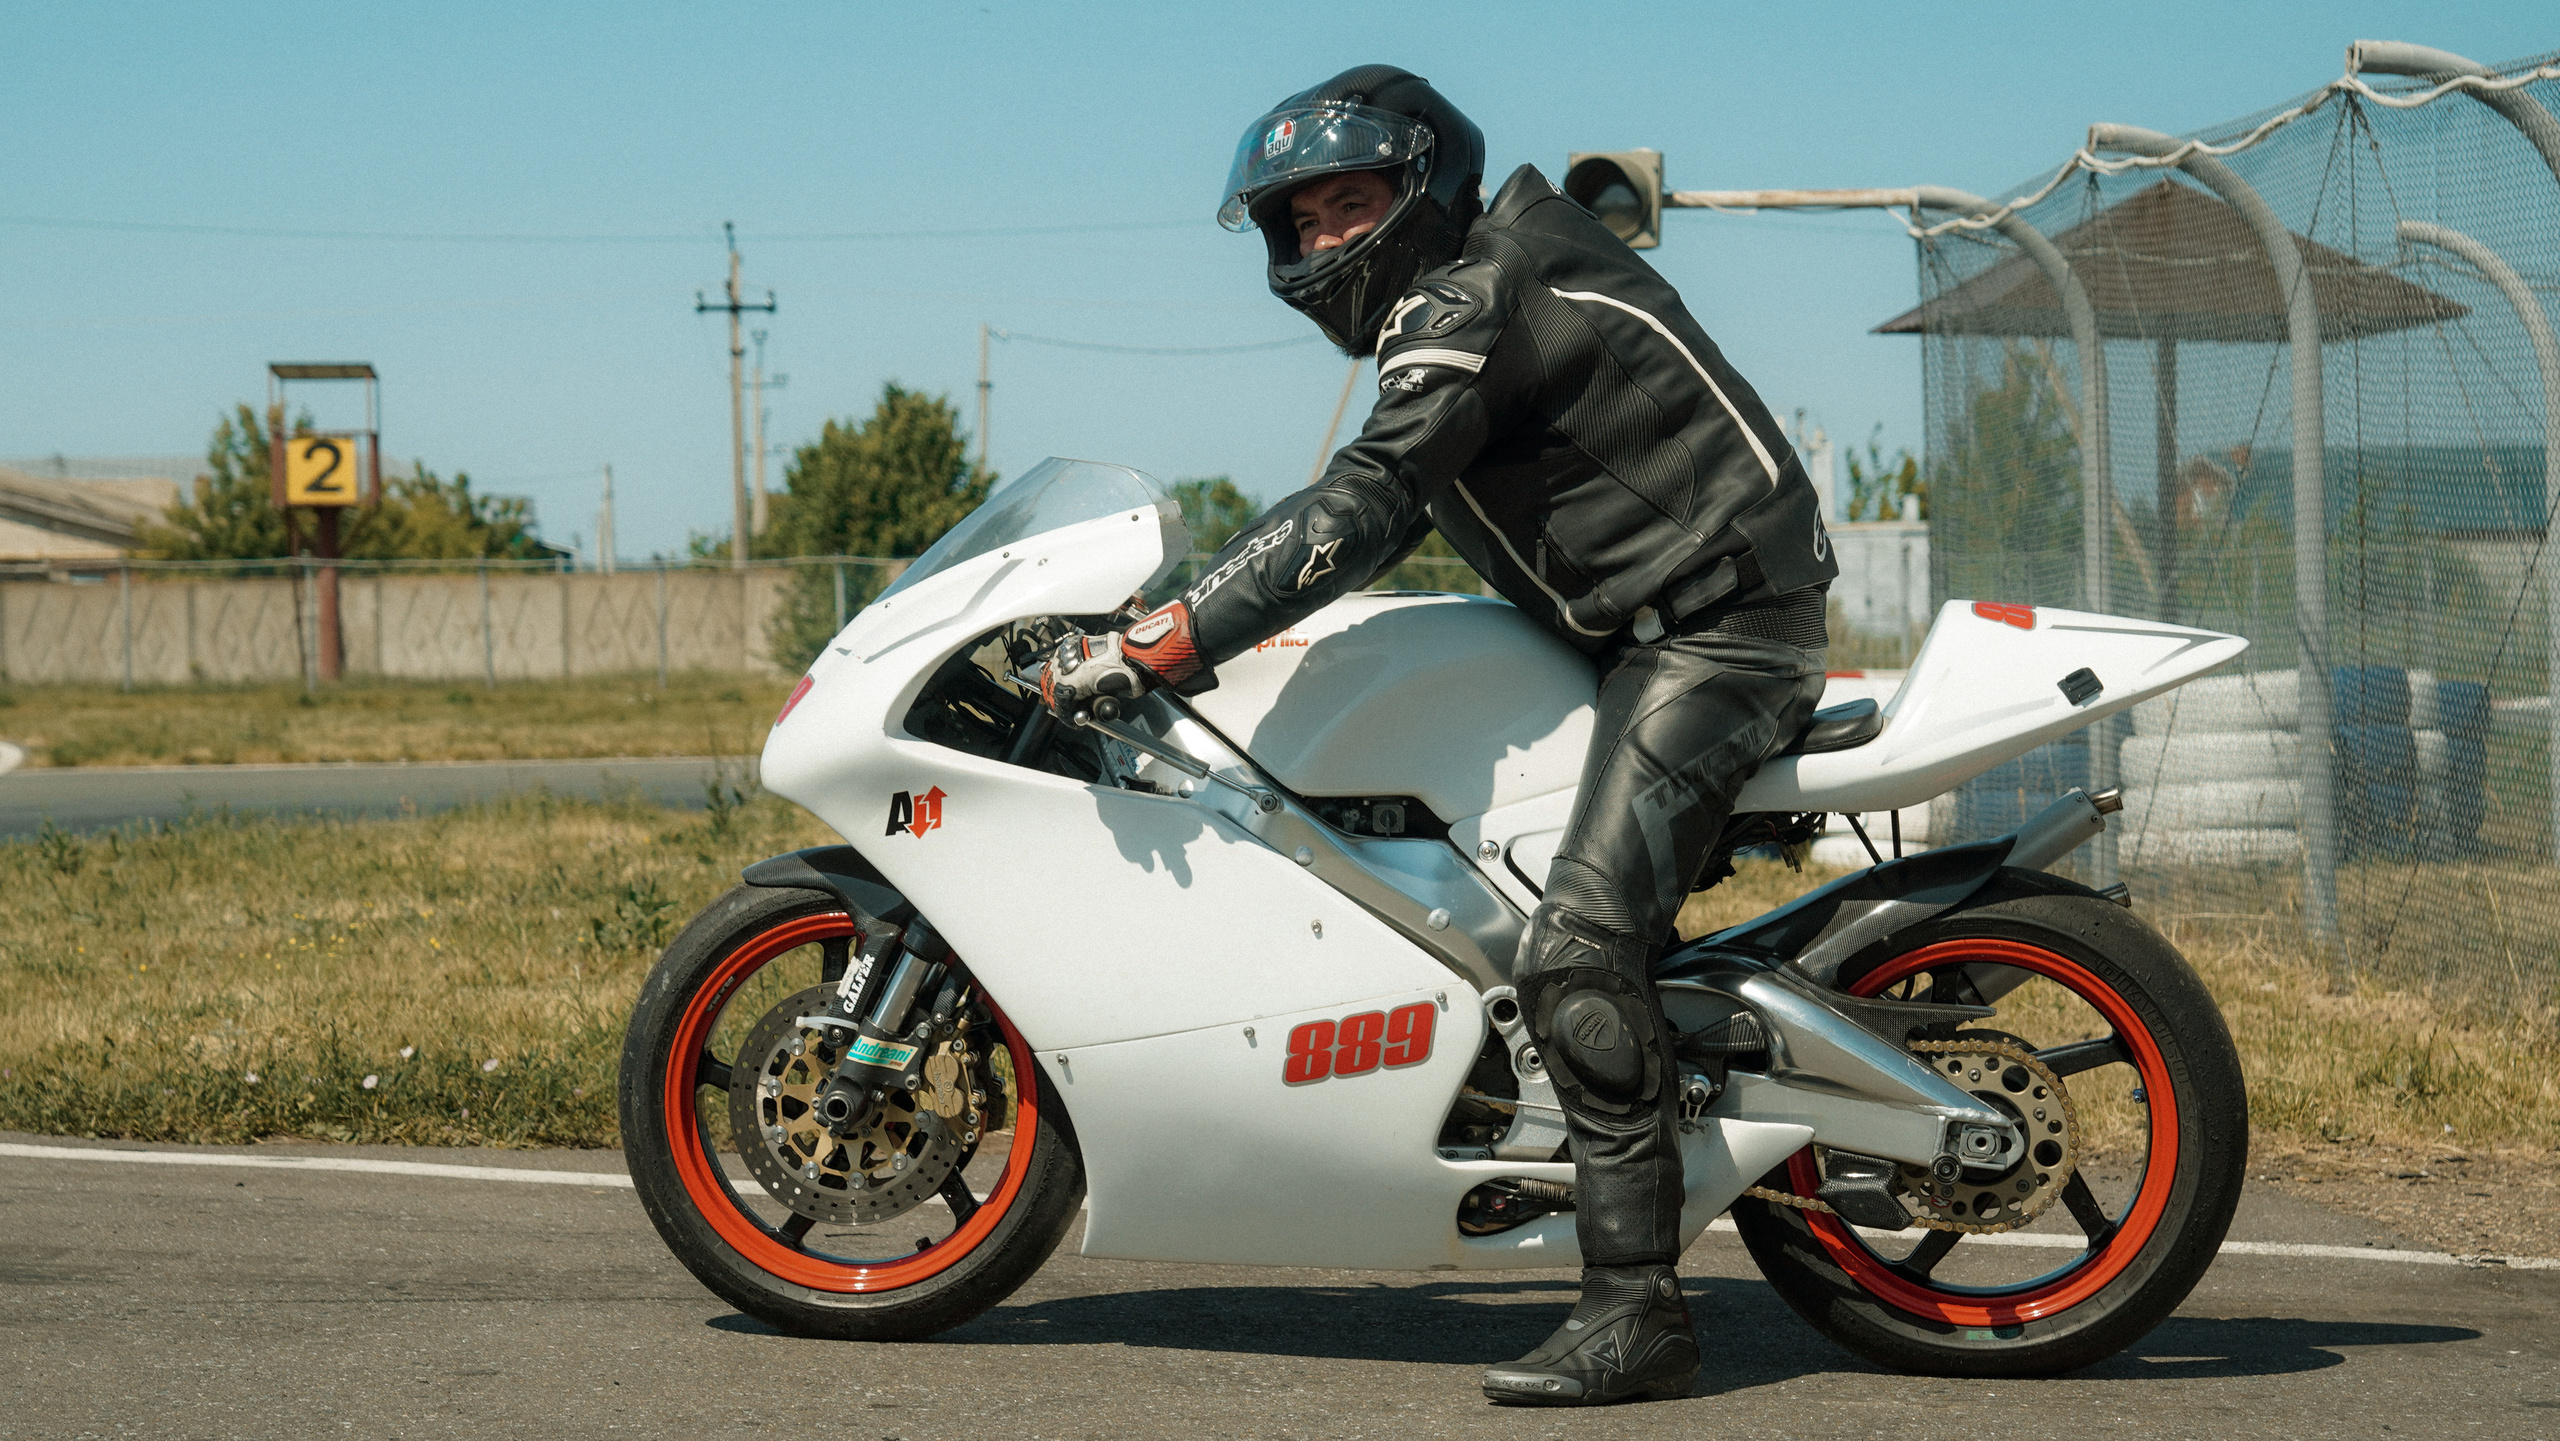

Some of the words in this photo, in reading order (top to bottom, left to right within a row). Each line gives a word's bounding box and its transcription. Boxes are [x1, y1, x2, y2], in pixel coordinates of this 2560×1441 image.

[305, 442, 343, 492] 2
[1134, 617, 1169, 635] DUCATI
[1252, 627, 1309, 653] prilia
[843, 953, 876, 1014] GALFER
[1580, 1016, 1603, 1041] DUCATI
[851, 1038, 914, 1063] Andreani
[1282, 1000, 1438, 1087] 889
